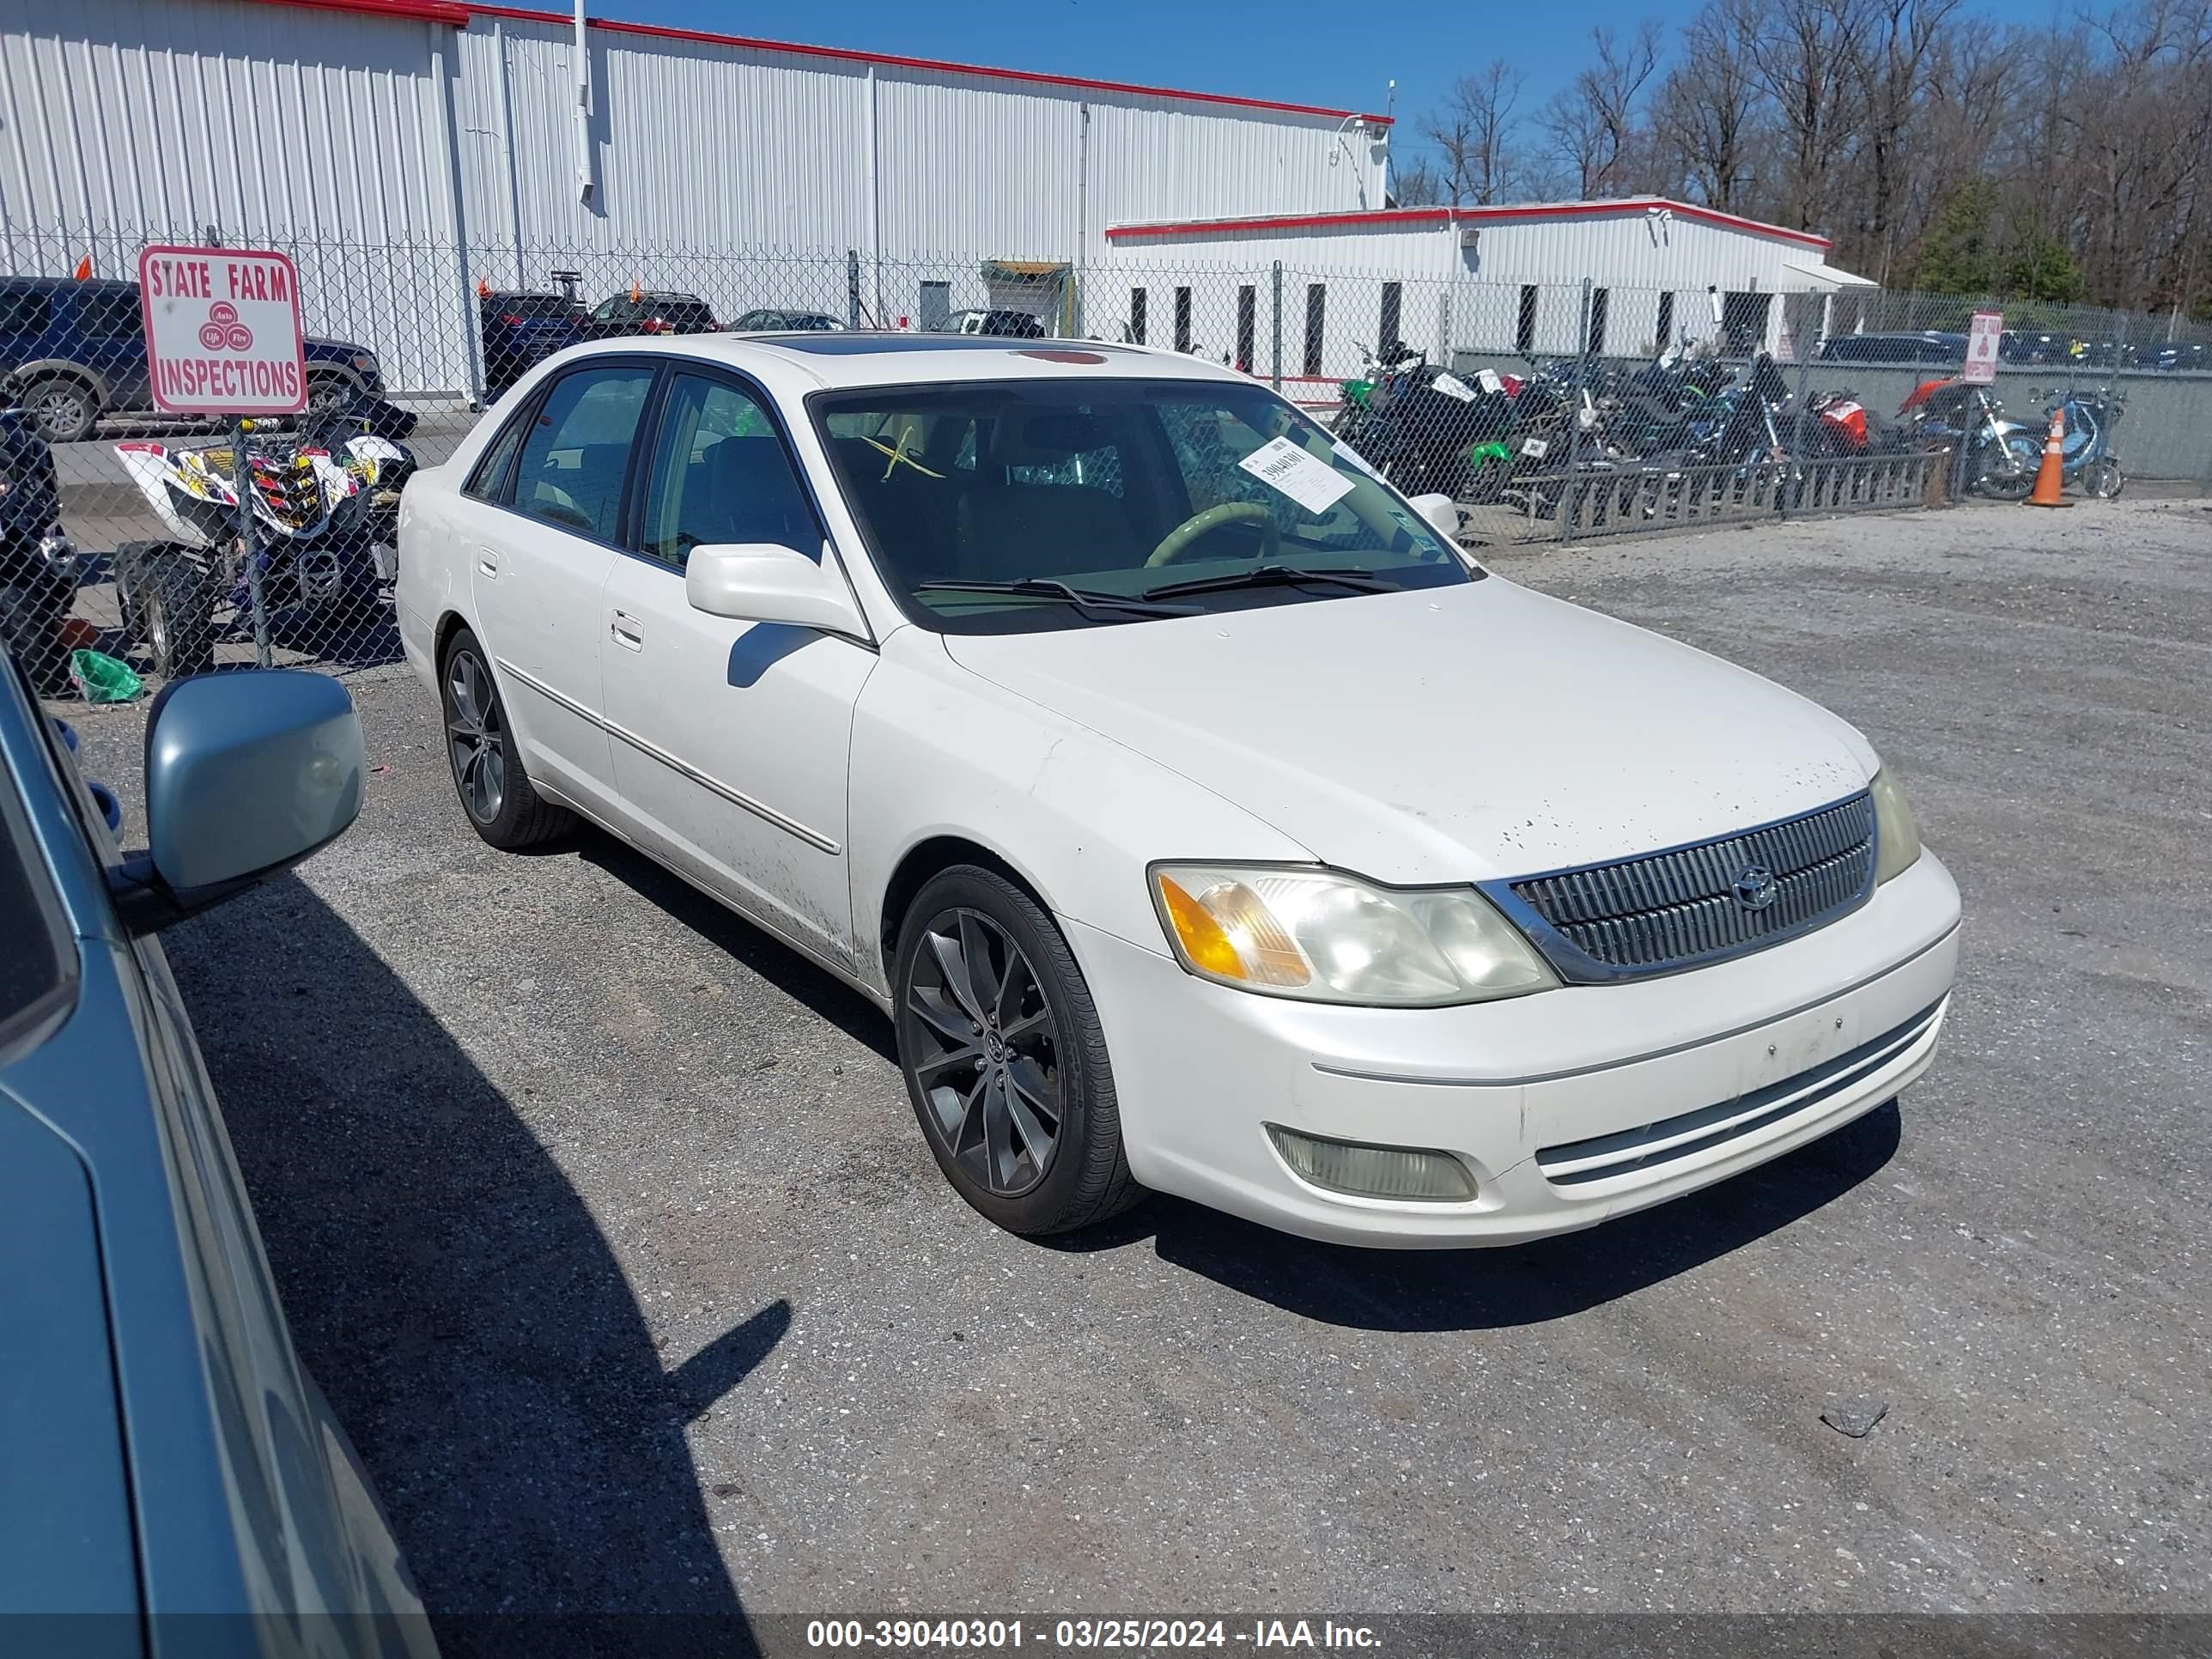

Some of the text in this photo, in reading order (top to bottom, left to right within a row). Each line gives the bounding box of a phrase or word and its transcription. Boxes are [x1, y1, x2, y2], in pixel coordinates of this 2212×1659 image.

[150, 259, 289, 302] STATE FARM
[216, 311, 233, 320] Auto
[206, 331, 247, 343] Life Fire
[159, 358, 298, 398] INSPECTIONS
[1261, 450, 1306, 481] 39040301
